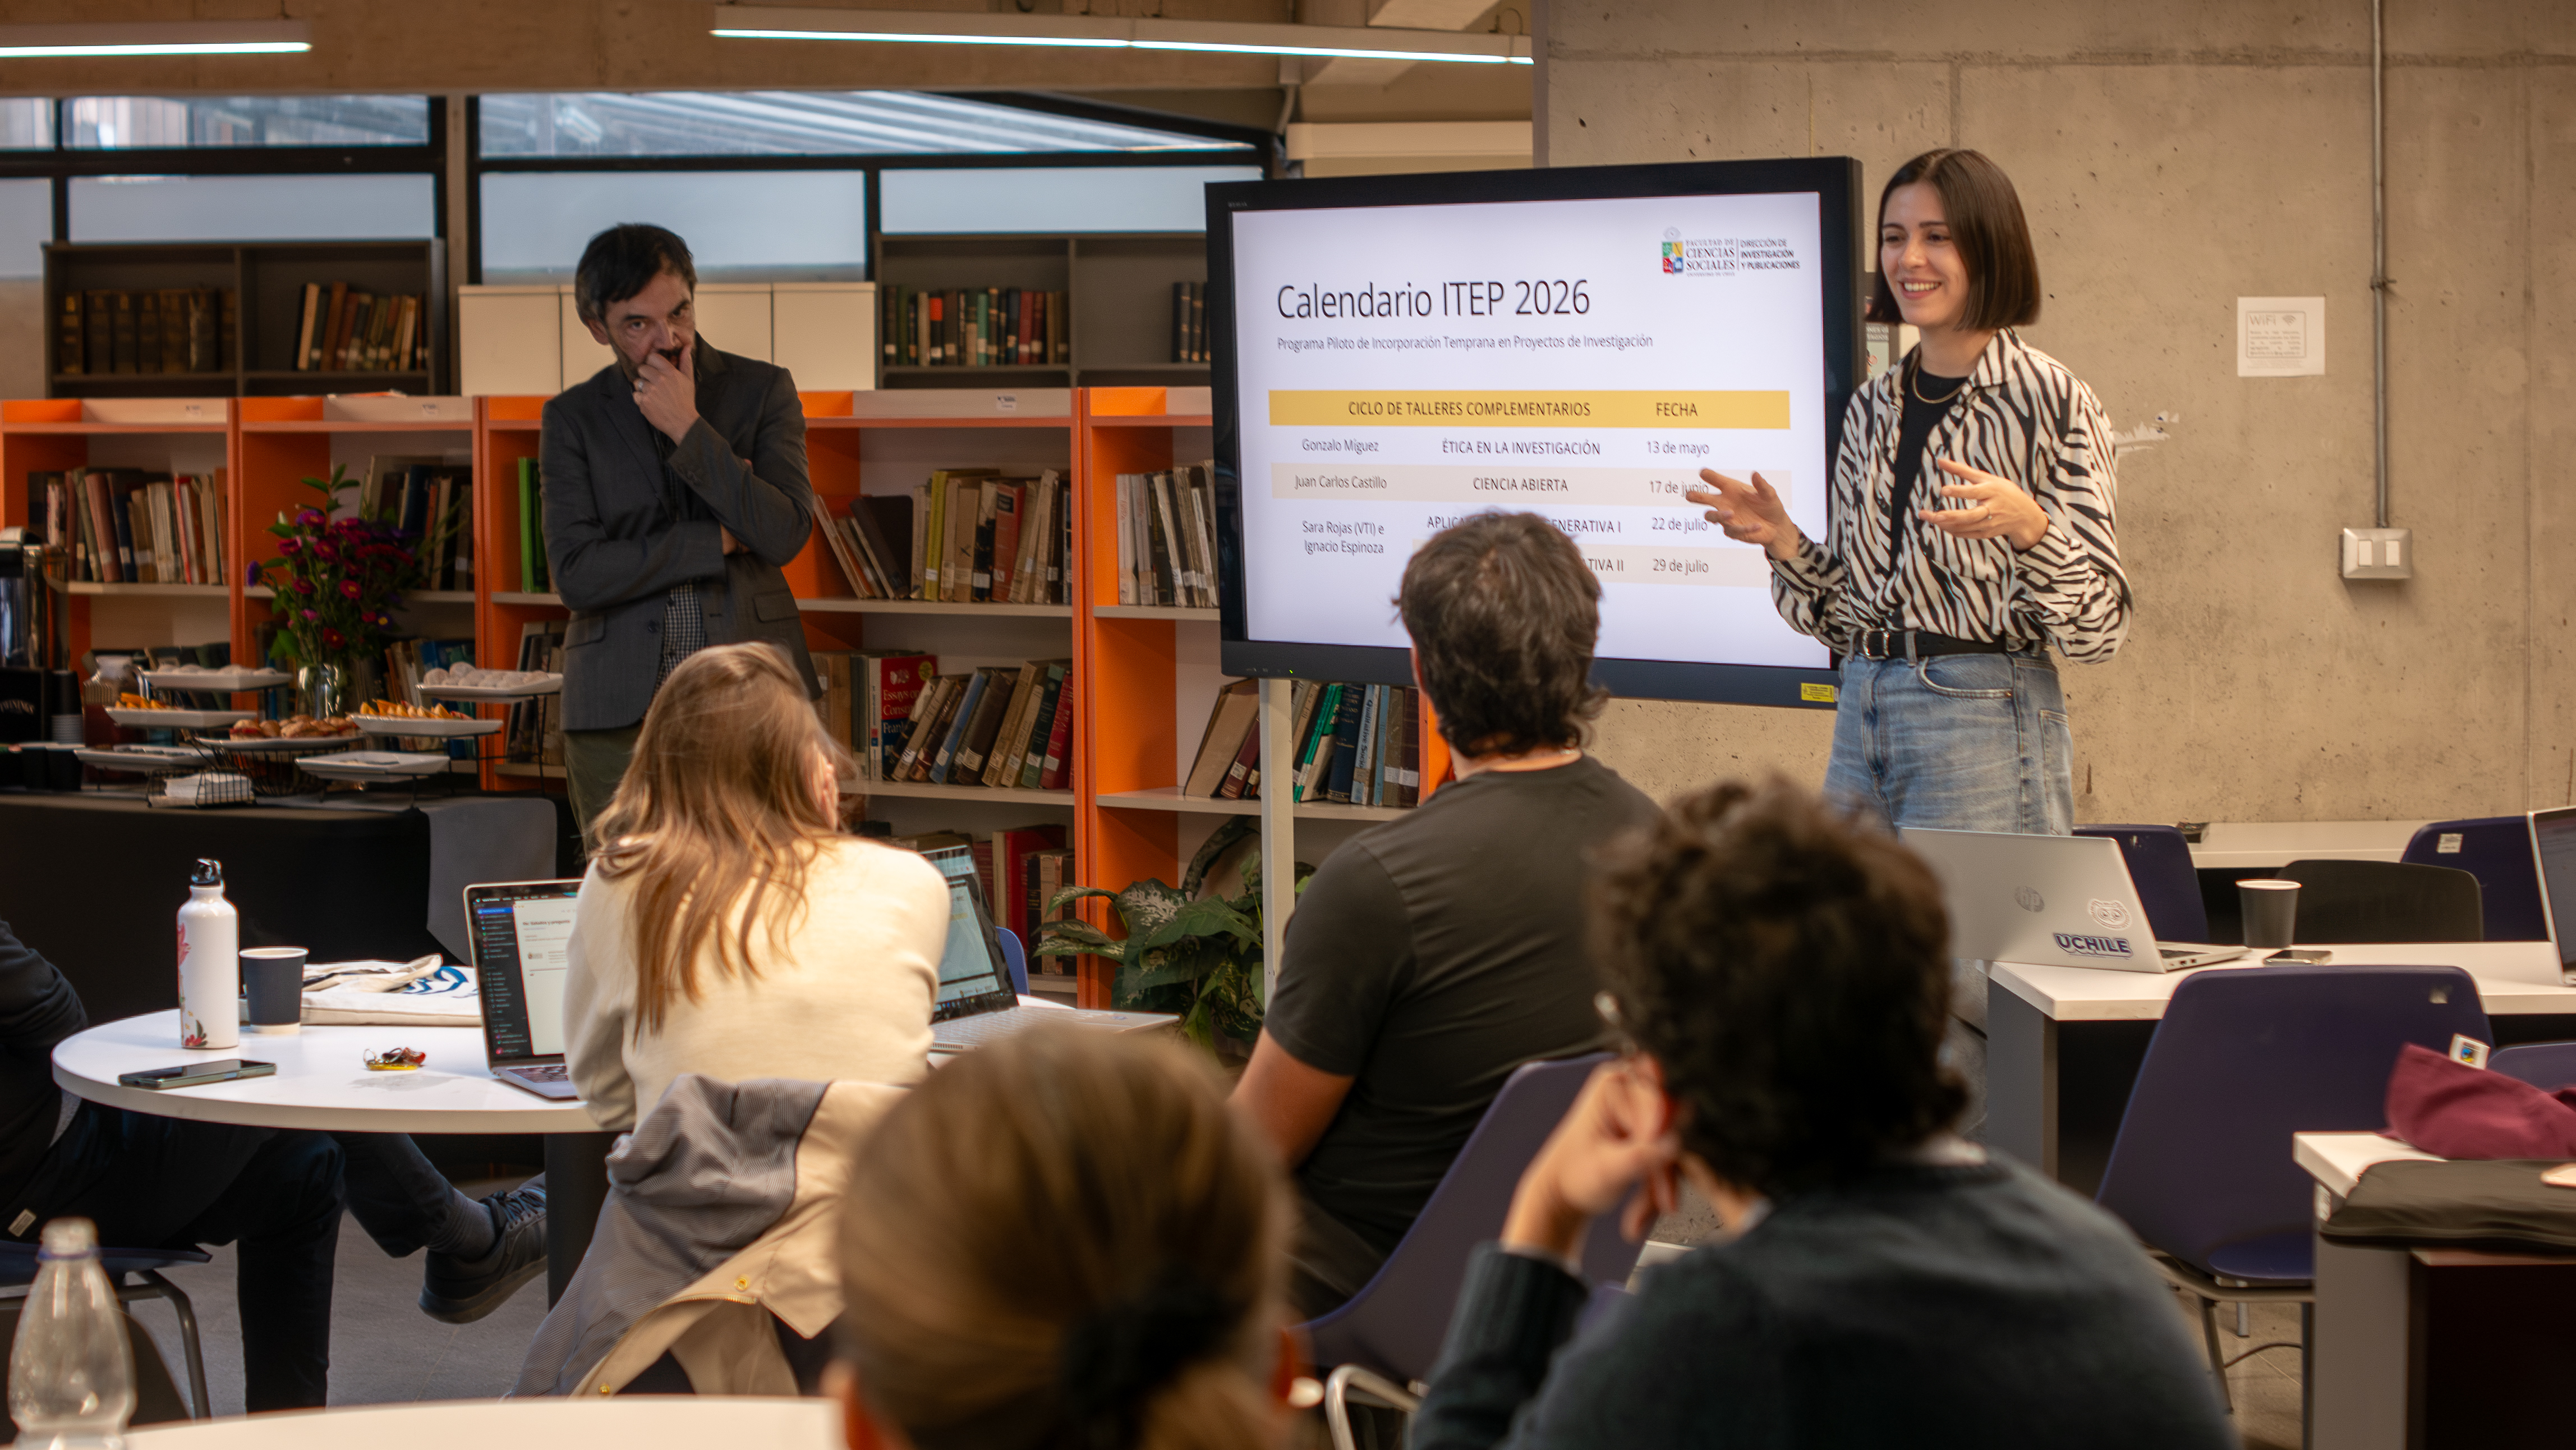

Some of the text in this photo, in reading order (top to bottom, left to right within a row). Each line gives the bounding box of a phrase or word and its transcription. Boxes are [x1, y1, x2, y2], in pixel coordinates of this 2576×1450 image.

[1740, 237, 1787, 247] DIRECCIÓN DE
[1686, 247, 1735, 259] CIENCIAS
[1740, 249, 1794, 259] INVESTIGACIÓN
[1686, 259, 1736, 270] SOCIALES
[1740, 260, 1801, 269] Y PUBLICACIONES
[1278, 279, 1590, 319] Calendario ITEP 2026
[1277, 334, 1653, 353] Programa Piloto de Incorporación Temprana en Proyectos de Investigación
[1349, 401, 1591, 417] CICLO DE TALLERES COMPLEMENTARIOS
[1656, 402, 1699, 417] FECHA
[1301, 438, 1341, 451] Gonzalo
[1442, 438, 1600, 455] ÉTICA EN LA INVESTIGACIÓN
[1647, 440, 1710, 458] 13 de mayo
[1294, 475, 1387, 490] Juan Carlos Castillo
[1473, 477, 1569, 492] CIENCIA ABIERTA
[1649, 480, 1662, 494] 17
[1664, 480, 1678, 494] de
[1302, 520, 1384, 537] Sara Rojas (VTI) e
[1549, 519, 1615, 533] ENERATIVA
[1617, 521, 1621, 533] I
[1652, 517, 1708, 534] 22 de julio
[1304, 539, 1384, 557] Ignacio Espinoza
[1653, 558, 1709, 576] 29 de julio
[2053, 933, 2132, 955] UCHILE
